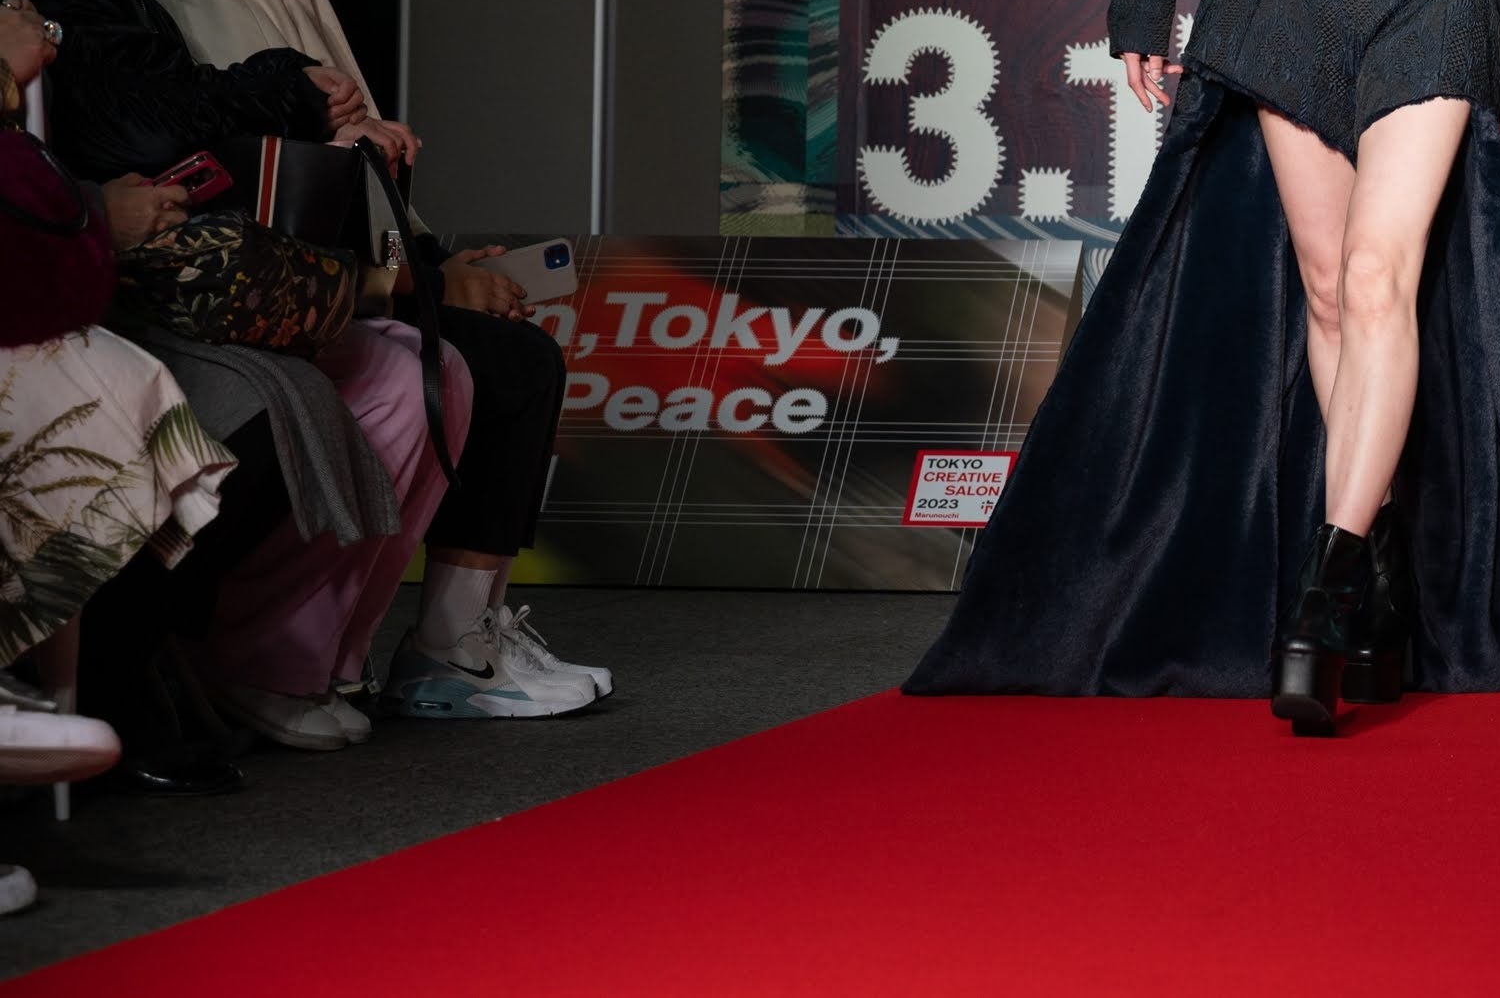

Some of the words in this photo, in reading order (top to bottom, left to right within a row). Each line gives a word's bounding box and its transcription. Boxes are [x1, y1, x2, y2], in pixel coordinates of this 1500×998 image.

[927, 458, 983, 469] TOKYO
[923, 471, 1003, 483] CREATIVE
[944, 485, 1001, 496] SALON
[916, 498, 959, 509] 2023
